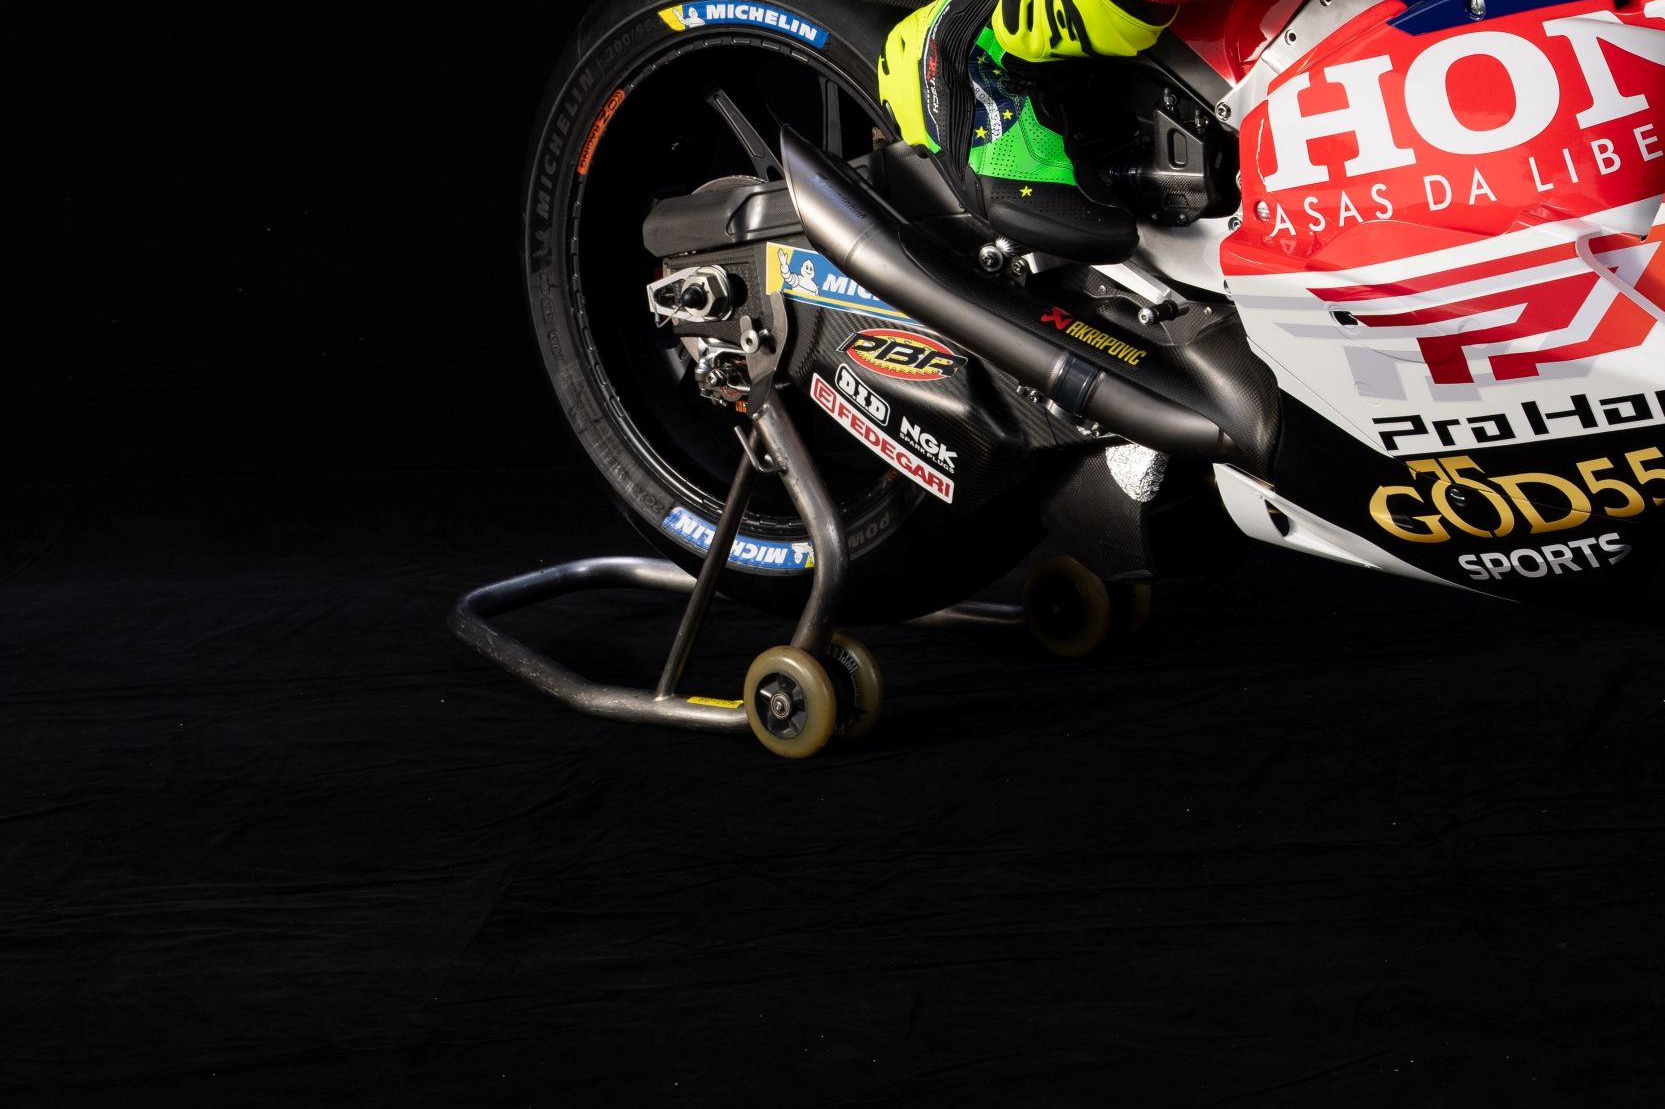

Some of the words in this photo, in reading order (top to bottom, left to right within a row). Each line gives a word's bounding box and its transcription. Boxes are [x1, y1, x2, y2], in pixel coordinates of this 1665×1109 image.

[706, 3, 818, 41] MICHELIN
[1267, 181, 1395, 238] ASAS
[1426, 167, 1498, 212] DA
[823, 273, 881, 302] MIC
[838, 332, 969, 377] PBR
[837, 402, 951, 499] FEDEGARI
[899, 433, 925, 456] SPARK
[926, 451, 955, 474] PLUGS
[900, 416, 958, 469] NGK
[675, 514, 787, 566] MICHLIN
[1457, 532, 1633, 582] SPORTS
